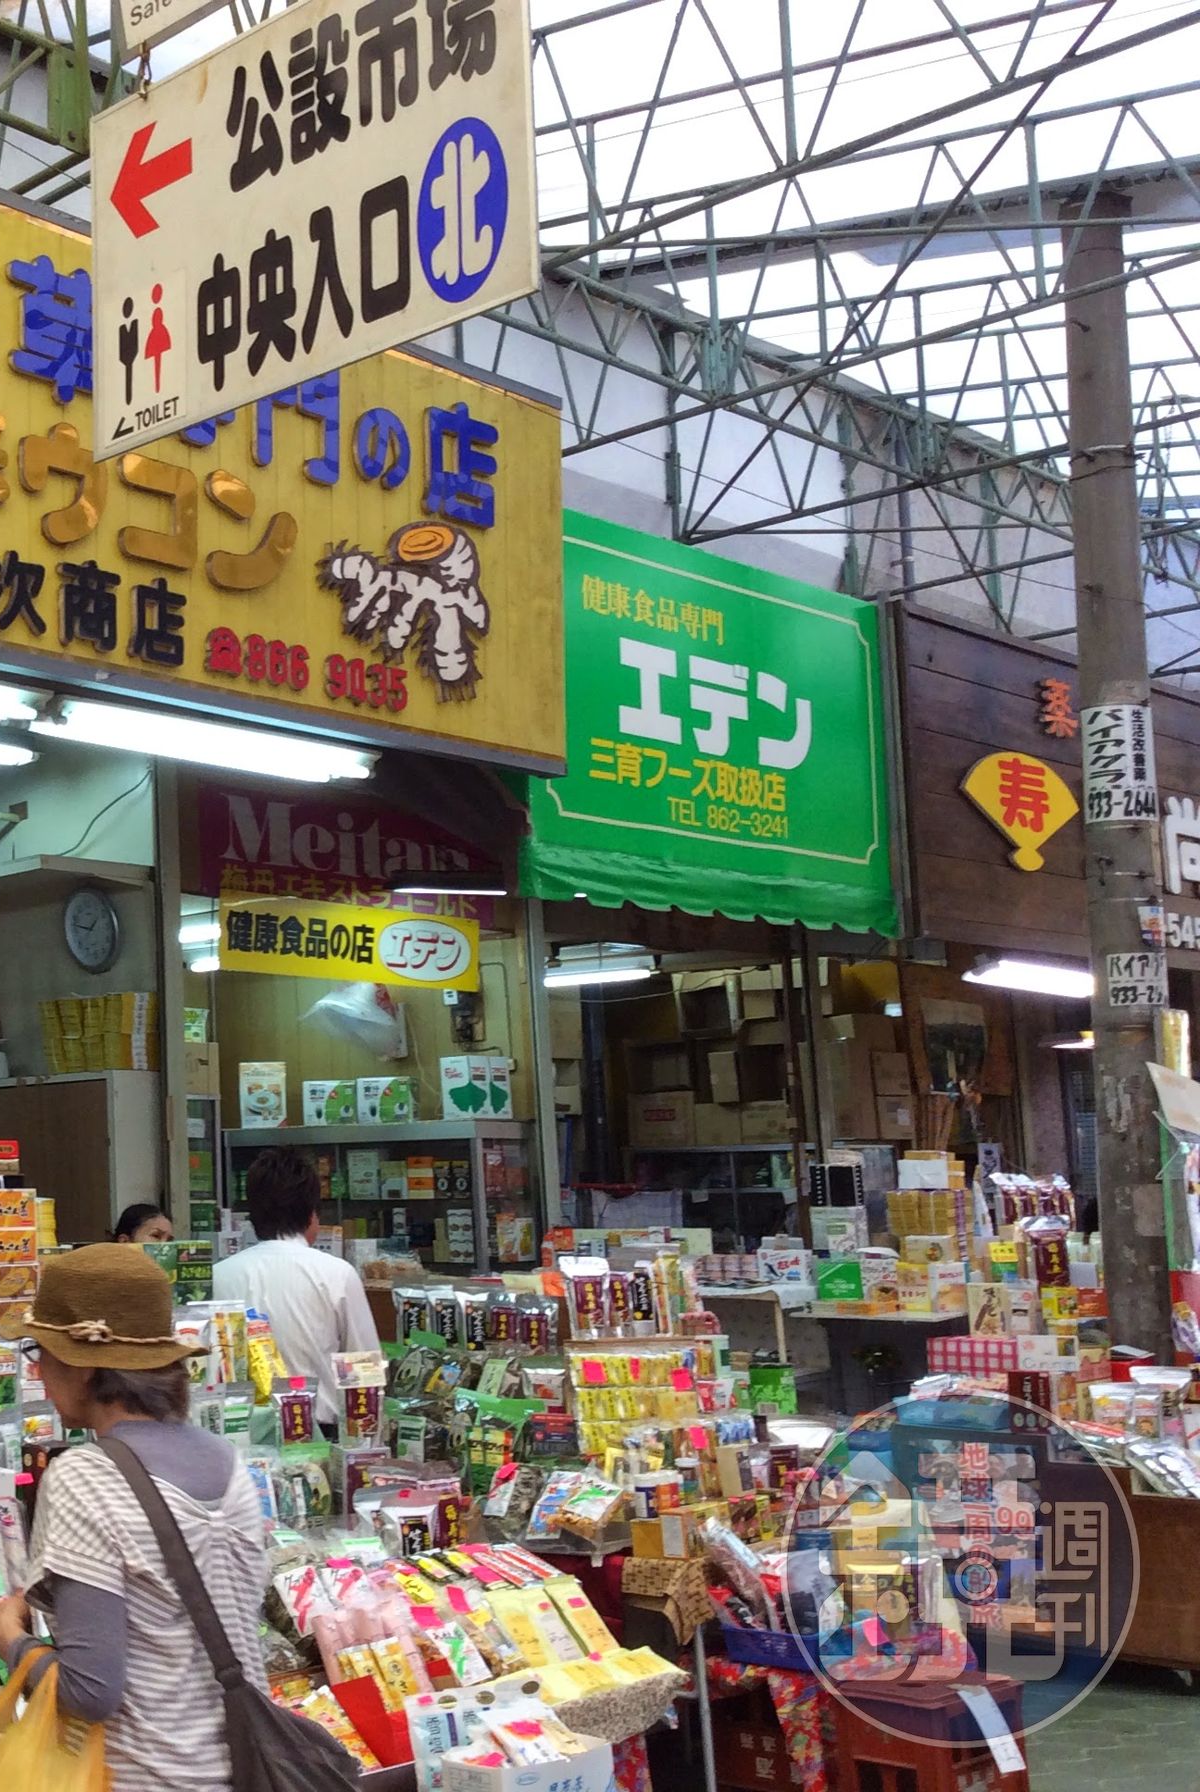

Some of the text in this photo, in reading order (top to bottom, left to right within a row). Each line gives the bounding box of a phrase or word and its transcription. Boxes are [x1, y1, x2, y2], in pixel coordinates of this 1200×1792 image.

[225, 0, 497, 193] 公設市場
[197, 175, 411, 391] 中央入口
[135, 396, 180, 431] TOILET
[582, 573, 724, 646] 健康食品専門
[245, 633, 309, 690] 866
[618, 636, 813, 770] エデン
[589, 737, 787, 813] 三育フーズ取扱店
[1087, 708, 1127, 784] バイアグラ
[667, 796, 789, 839] TEL 862-3241
[995, 756, 1050, 833] 寿
[227, 910, 462, 972] 健康食品の店 エデン
[996, 1507, 1034, 1536] 99
